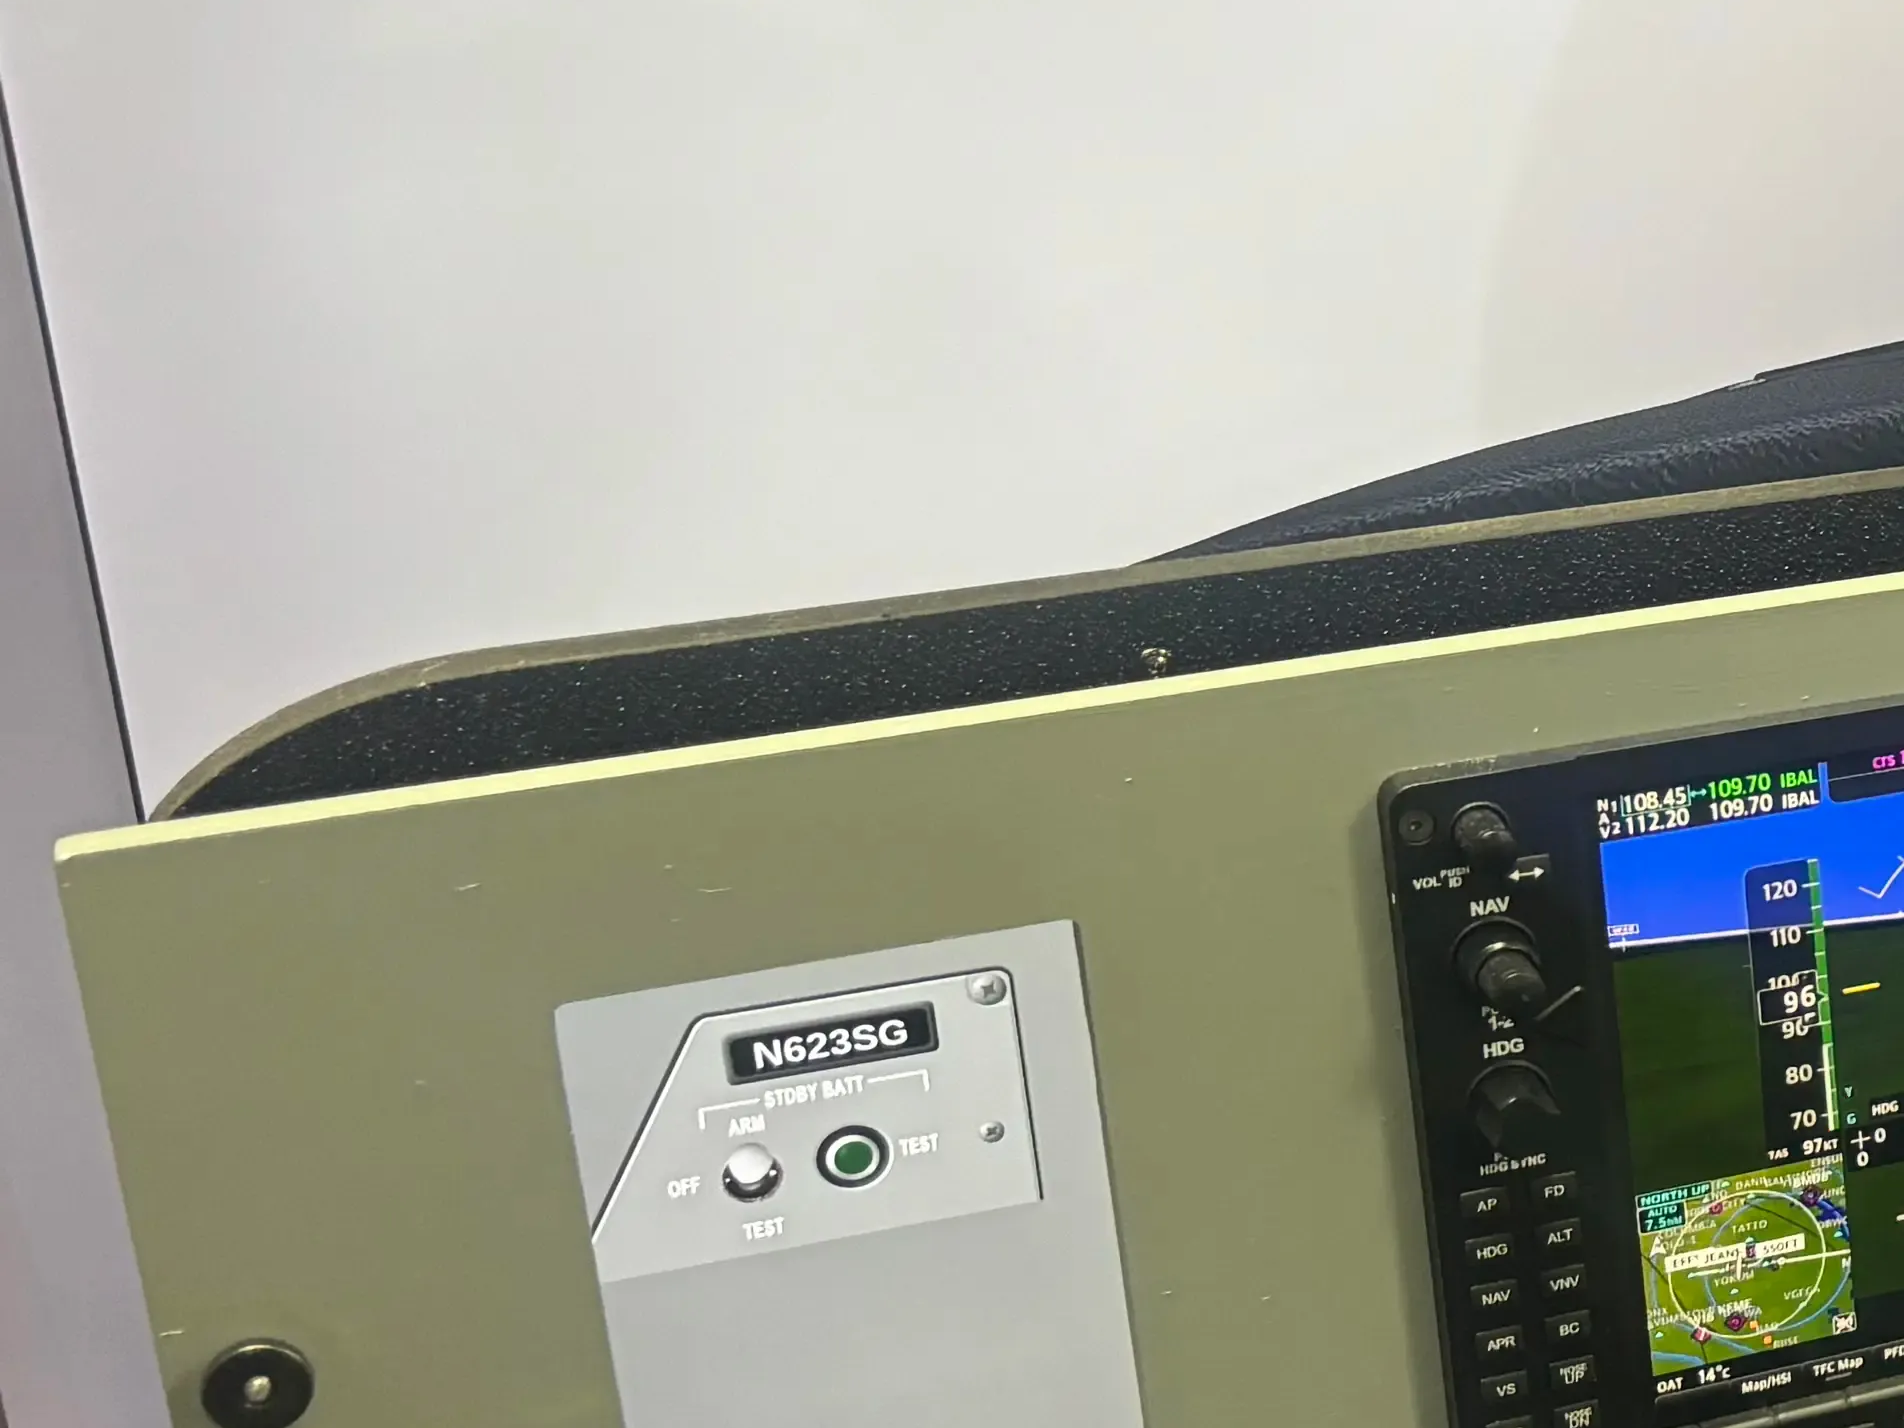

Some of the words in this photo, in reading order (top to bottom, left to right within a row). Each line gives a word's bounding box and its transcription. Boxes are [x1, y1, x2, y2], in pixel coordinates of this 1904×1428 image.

[1623, 786, 1687, 815] 108.45
[1709, 773, 1770, 799] 109.70
[1780, 770, 1817, 788] IBAL
[1627, 810, 1689, 834] 112.20
[1710, 795, 1772, 820] 109.70
[1782, 791, 1819, 809] IBAL
[1762, 880, 1797, 901] 120
[1470, 897, 1509, 917] NAV
[1770, 926, 1801, 946] 110
[1784, 986, 1816, 1013] 96
[753, 1019, 909, 1070] N623SG
[1483, 1038, 1524, 1058] HDG
[1786, 1065, 1812, 1084] 80
[764, 1083, 817, 1110] STDBY
[823, 1075, 865, 1100] BATT
[1872, 1100, 1898, 1117] HDG
[729, 1116, 764, 1136] ARM
[1791, 1110, 1816, 1129] 70
[900, 1134, 939, 1156] TEST
[668, 1177, 700, 1199] OFF
[1545, 1183, 1564, 1198] FD
[1477, 1198, 1497, 1213] AP
[743, 1218, 784, 1240] TEST
[1547, 1228, 1573, 1245] ALT
[1477, 1241, 1507, 1258] HDG
[1550, 1274, 1580, 1291] VNV
[1482, 1289, 1511, 1306] NAV
